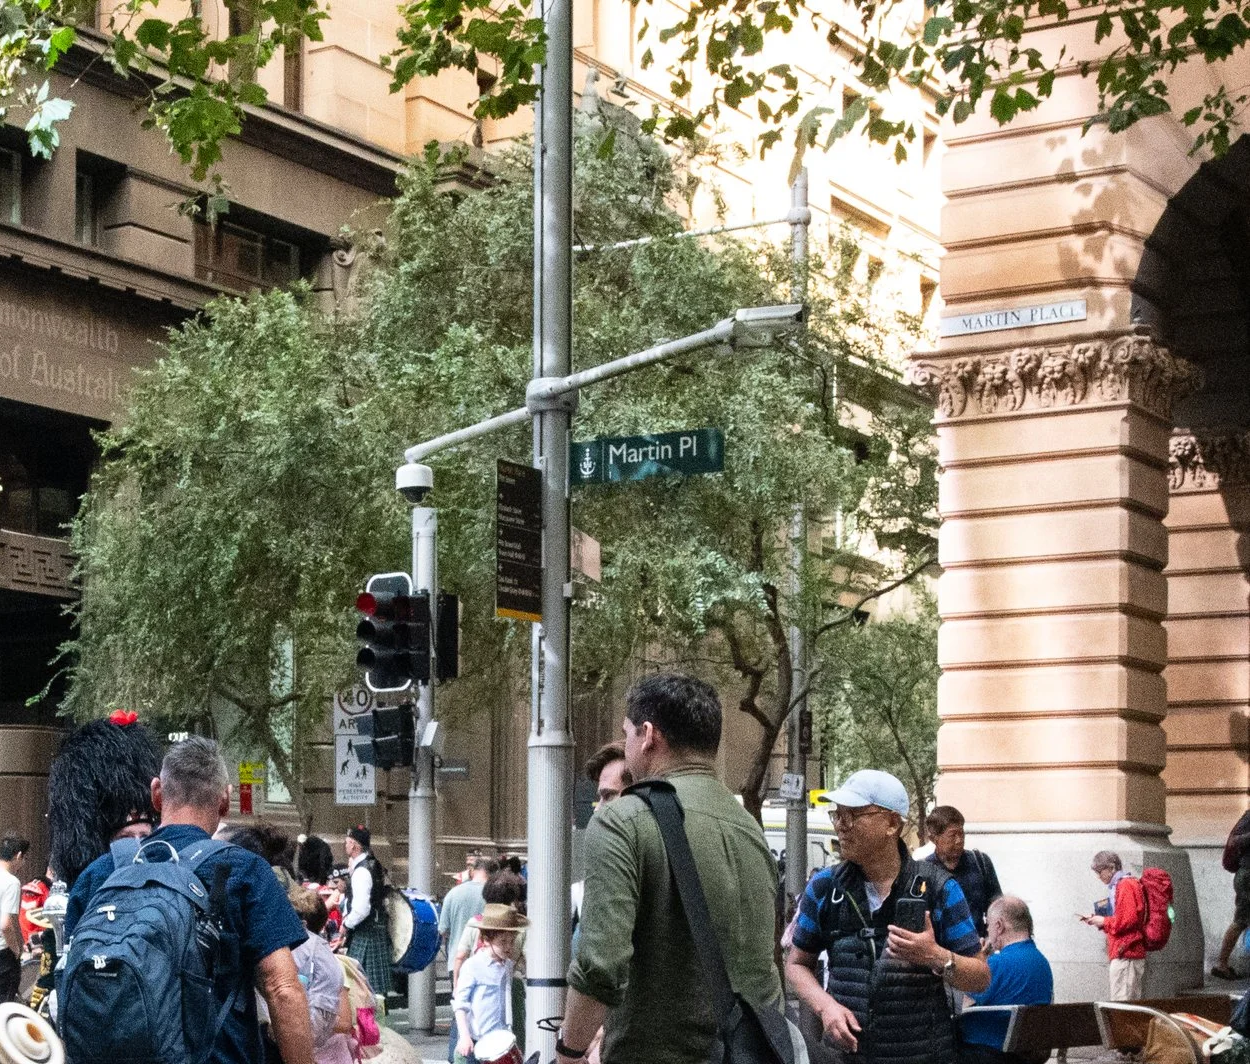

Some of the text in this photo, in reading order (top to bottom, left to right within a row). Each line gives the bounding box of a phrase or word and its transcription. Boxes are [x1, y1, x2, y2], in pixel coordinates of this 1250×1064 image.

[962, 304, 1078, 330] MARTIN PLACE
[0, 343, 22, 379] of
[31, 350, 127, 405] Australi
[609, 436, 697, 465] Martin Pl
[339, 718, 356, 730] AR
